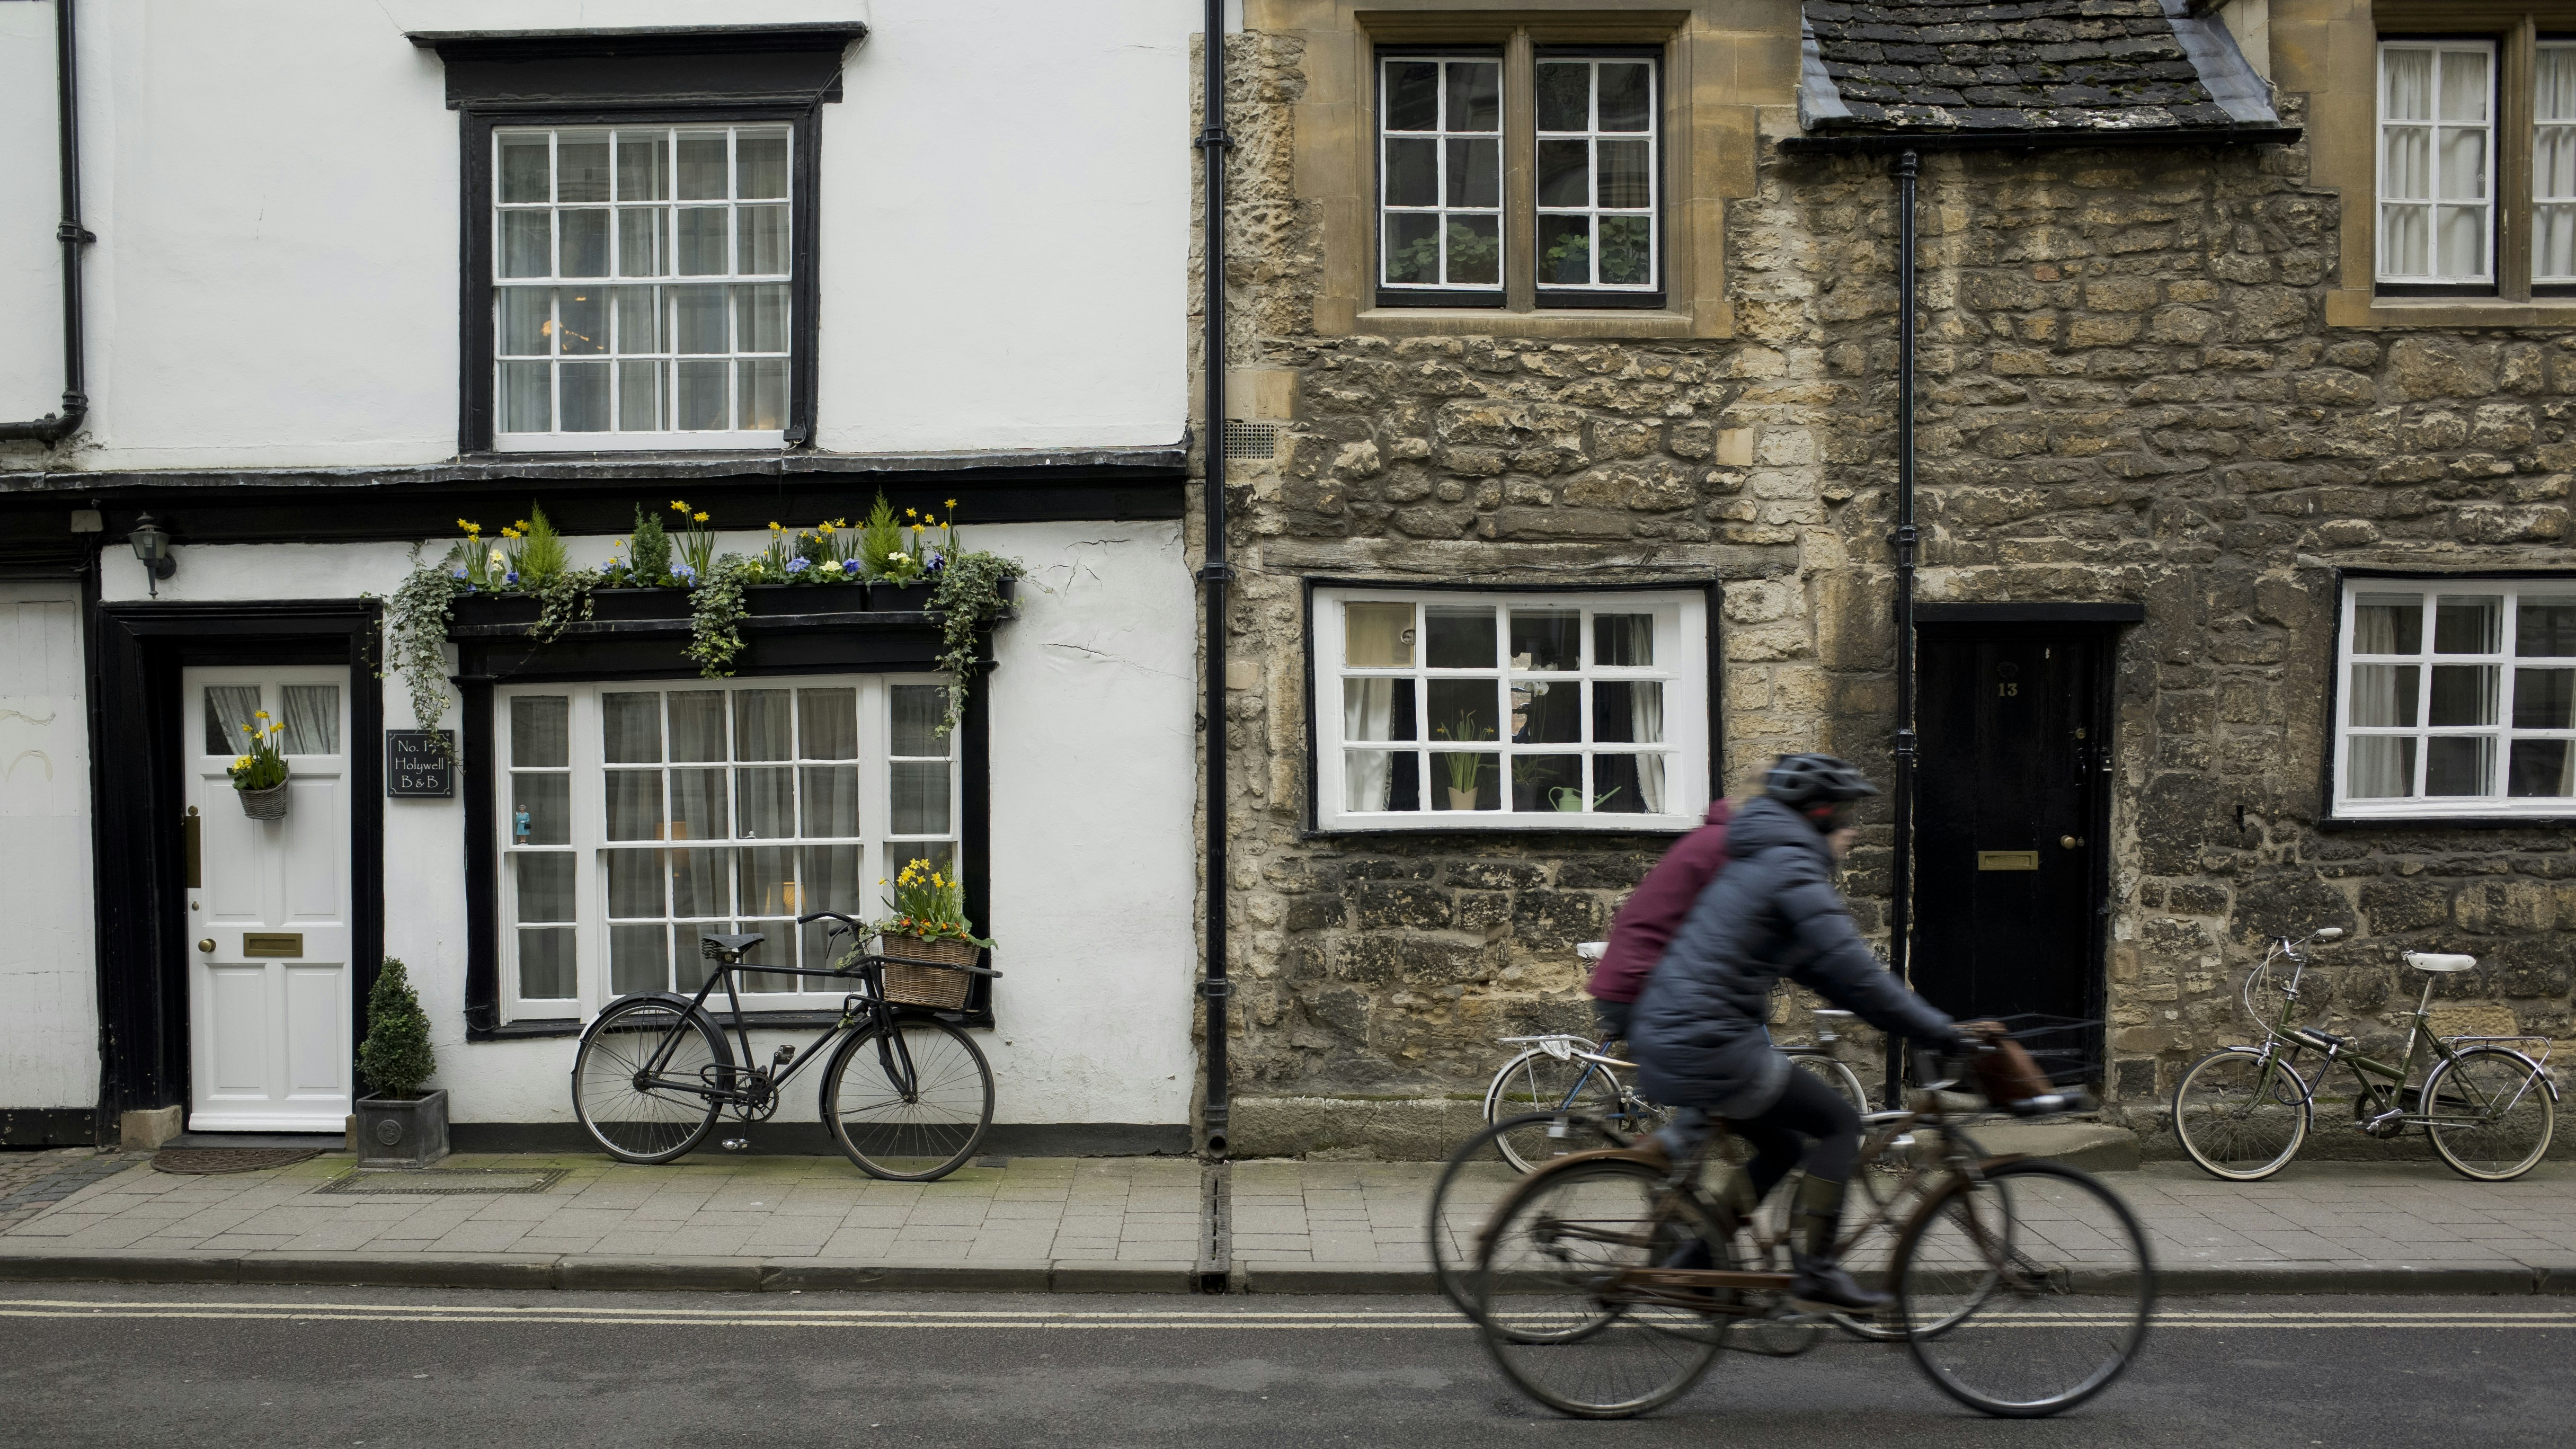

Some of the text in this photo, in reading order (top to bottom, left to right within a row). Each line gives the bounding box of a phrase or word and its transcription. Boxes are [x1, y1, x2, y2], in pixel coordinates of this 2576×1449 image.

[1998, 683, 2018, 696] 13
[398, 740, 419, 752] No.
[395, 758, 443, 774] Holywell
